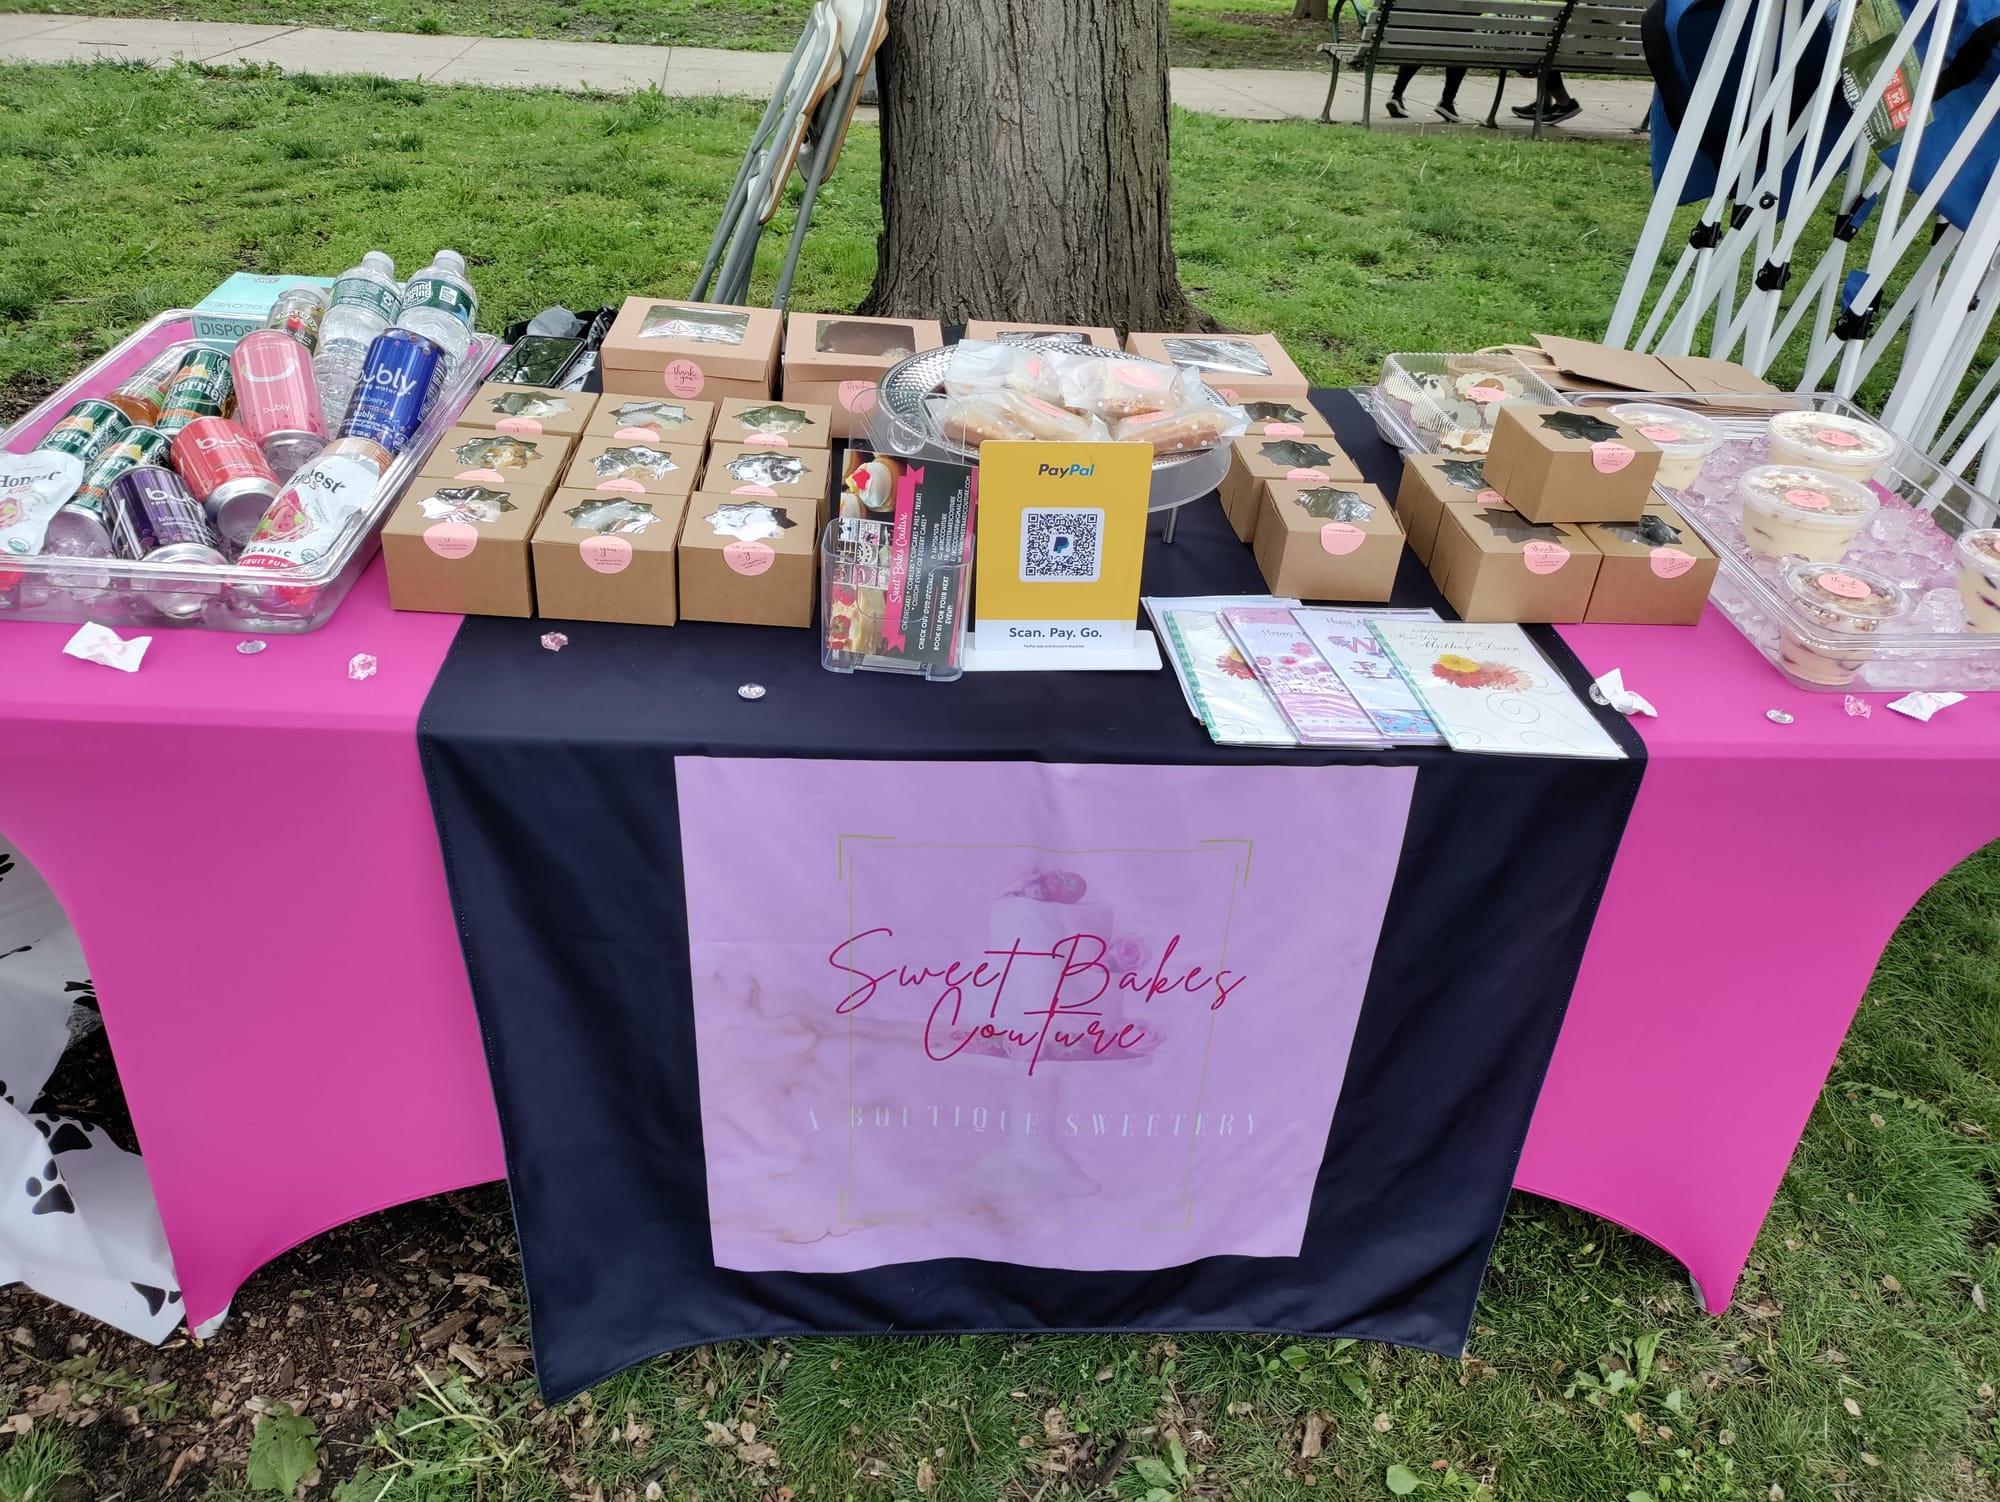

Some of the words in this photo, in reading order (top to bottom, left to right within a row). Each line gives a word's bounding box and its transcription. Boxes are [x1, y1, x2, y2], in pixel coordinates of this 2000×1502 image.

[200, 322, 263, 337] DISPOS
[263, 403, 291, 414] bubly
[1038, 464, 1095, 479] PayPal
[914, 492, 922, 511] TREATS
[895, 512, 909, 547] Couture
[919, 518, 927, 536] CAKES
[909, 530, 919, 559] CUPCAKES
[917, 535, 925, 558] DESSERT
[892, 549, 906, 576] Bakes
[916, 557, 924, 567] OR
[906, 562, 915, 591] COBBLERS
[941, 576, 949, 591] NEXT
[889, 577, 903, 604] Sweet
[912, 584, 921, 607] CUSTOM
[938, 591, 948, 609] YOUR
[921, 614, 930, 630] OUT
[937, 609, 946, 623] FOR
[936, 622, 944, 632] US
[1009, 627, 1045, 638] Scan.
[1049, 627, 1076, 640] Pay.
[1080, 627, 1102, 638] Go.
[918, 630, 929, 651] CHECK
[933, 631, 944, 651] BOOK
[828, 928, 1063, 1017] Sweet
[1053, 934, 1247, 1010] Bakes
[924, 986, 1146, 1075] Couture
[807, 1107, 821, 1132] A
[849, 1104, 1040, 1136] BOUTIQUE
[1065, 1112, 1257, 1138] SWEETERY
